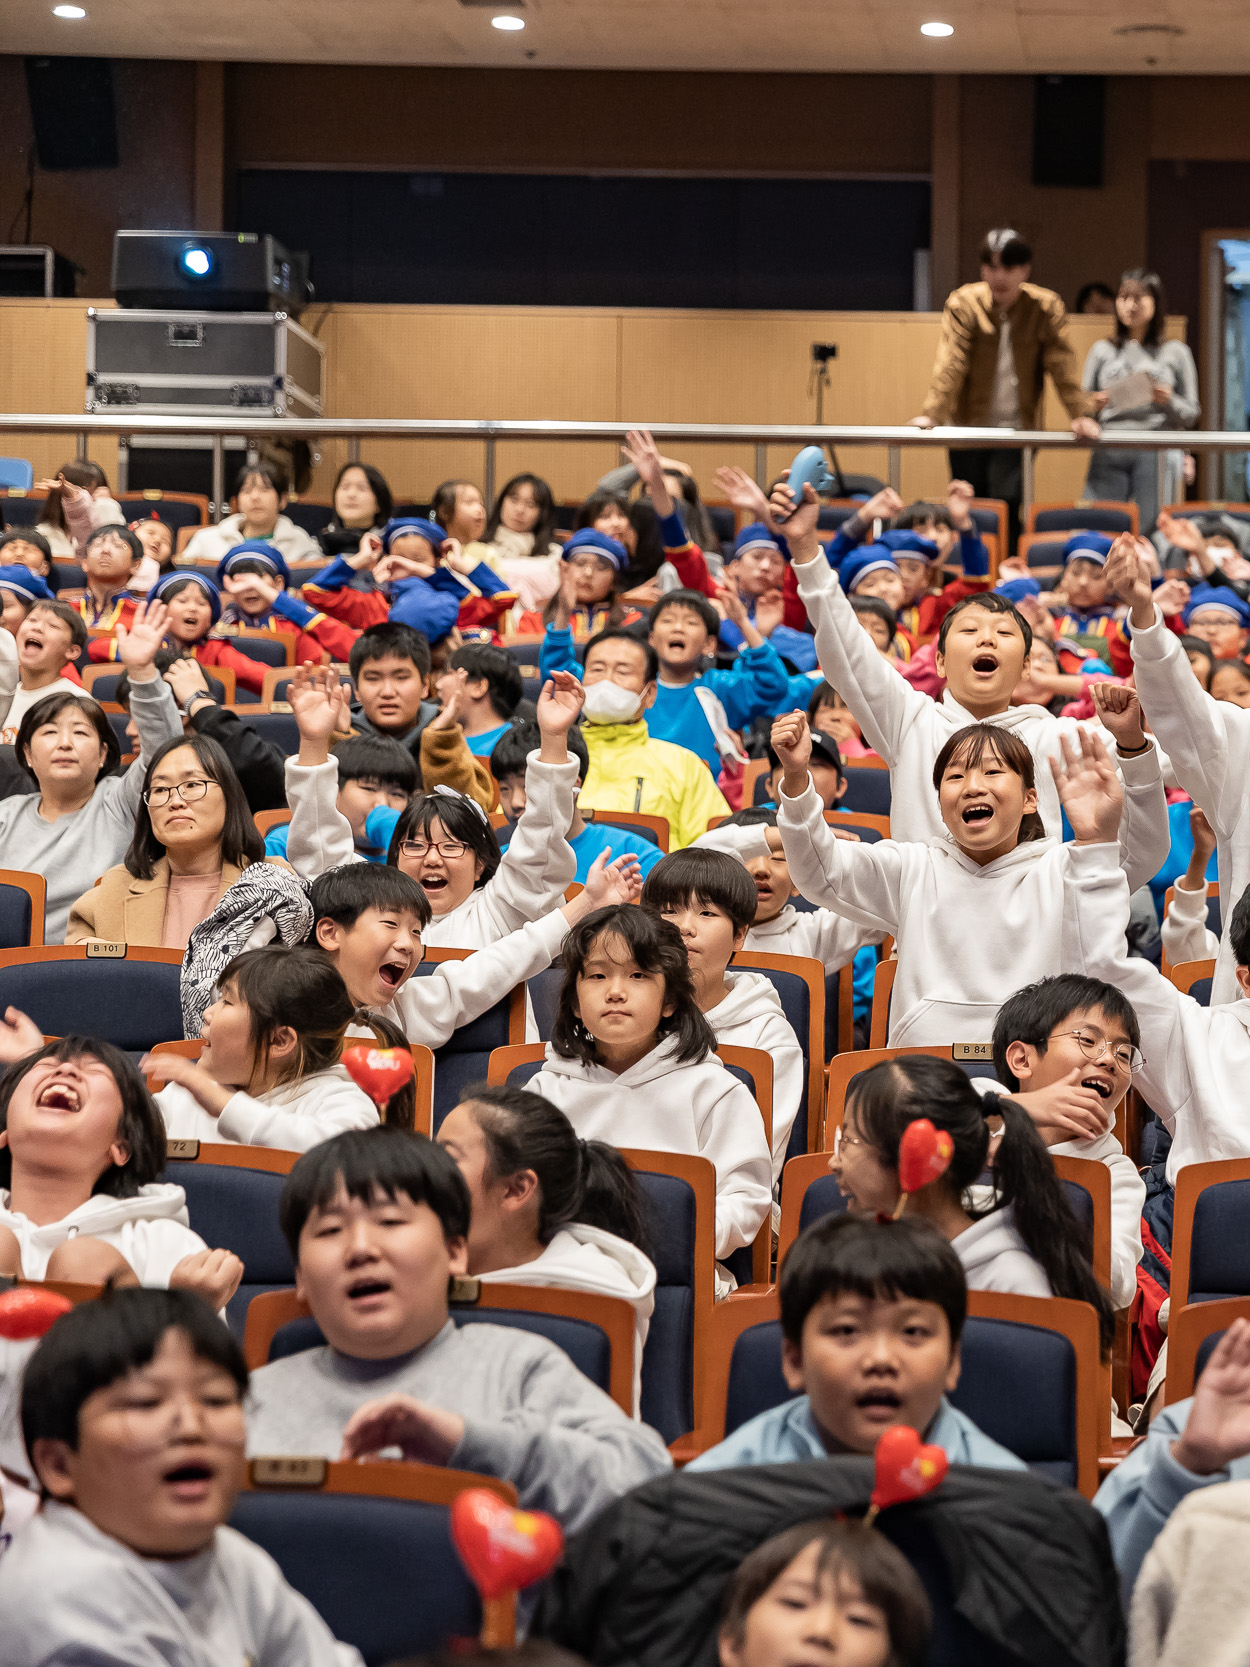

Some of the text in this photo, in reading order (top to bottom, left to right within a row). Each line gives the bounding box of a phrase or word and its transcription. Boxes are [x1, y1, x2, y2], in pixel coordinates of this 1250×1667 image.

[963, 1046, 986, 1054] B 84
[173, 1141, 186, 1151] 72
